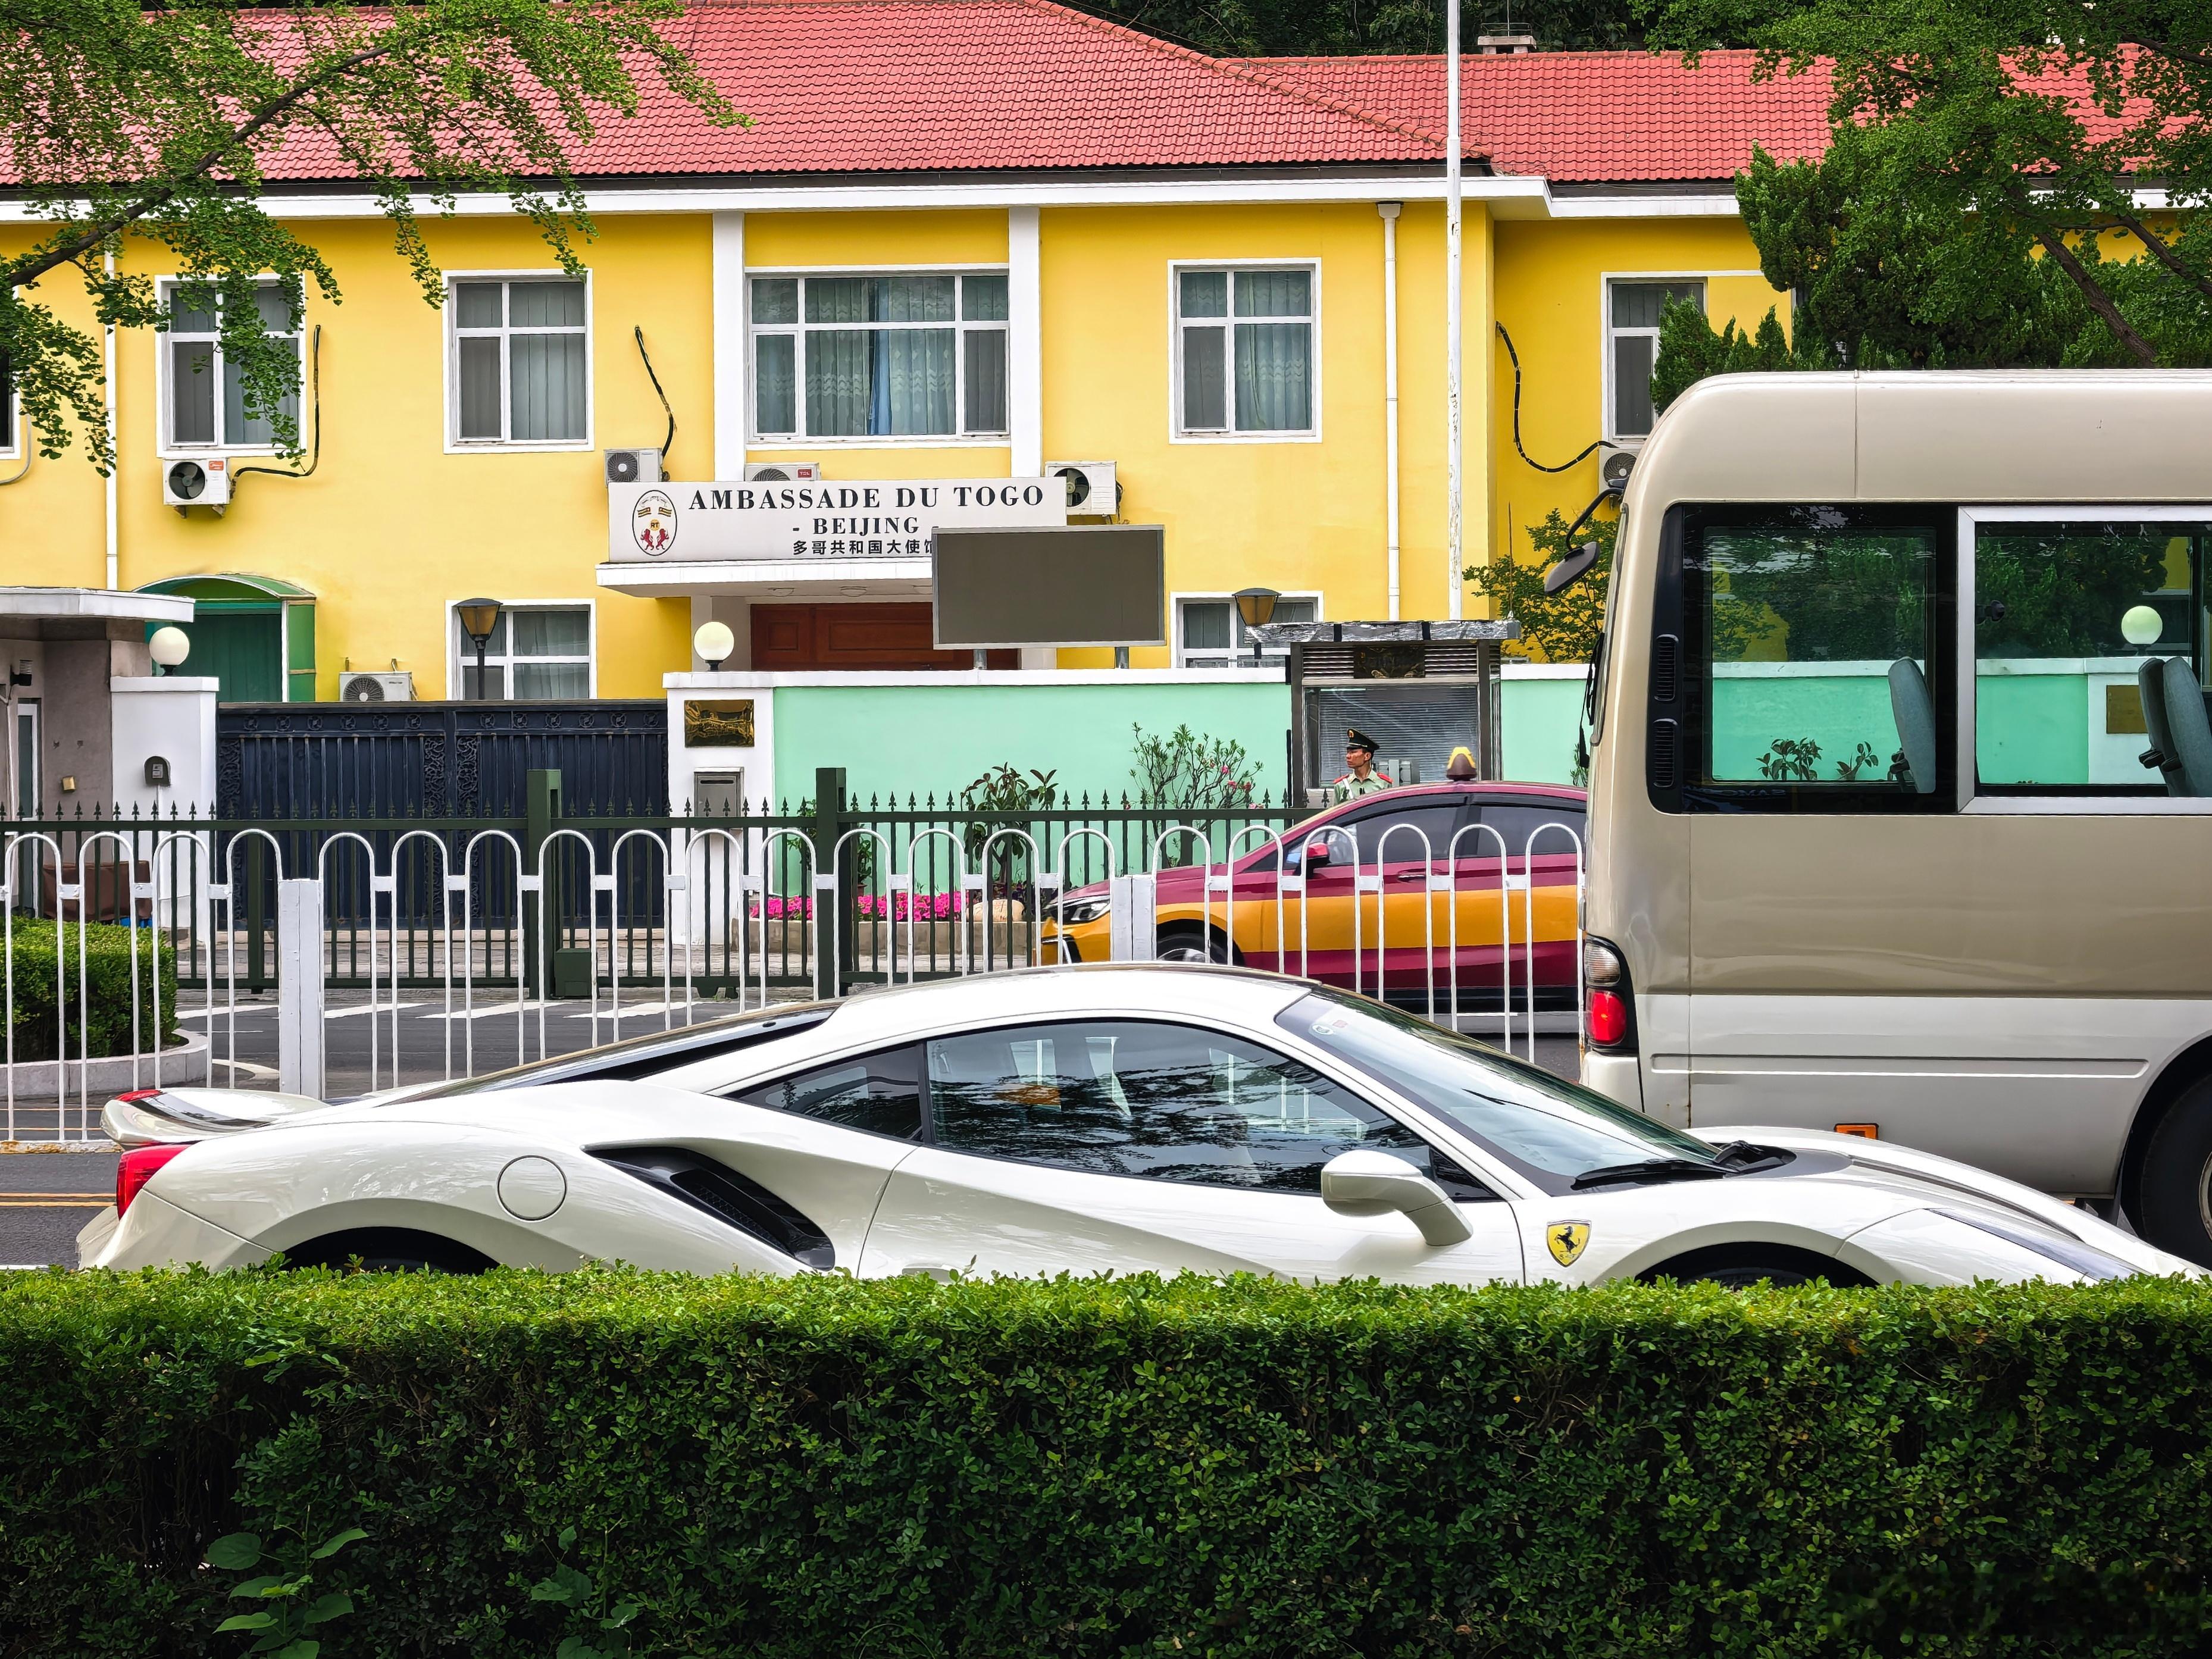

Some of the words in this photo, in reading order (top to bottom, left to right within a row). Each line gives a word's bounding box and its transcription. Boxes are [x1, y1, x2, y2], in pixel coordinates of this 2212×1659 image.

[689, 489, 880, 510] AMBASSADE
[895, 487, 939, 508] DU
[953, 485, 1043, 507] TOGO
[813, 517, 919, 537] BEIJING
